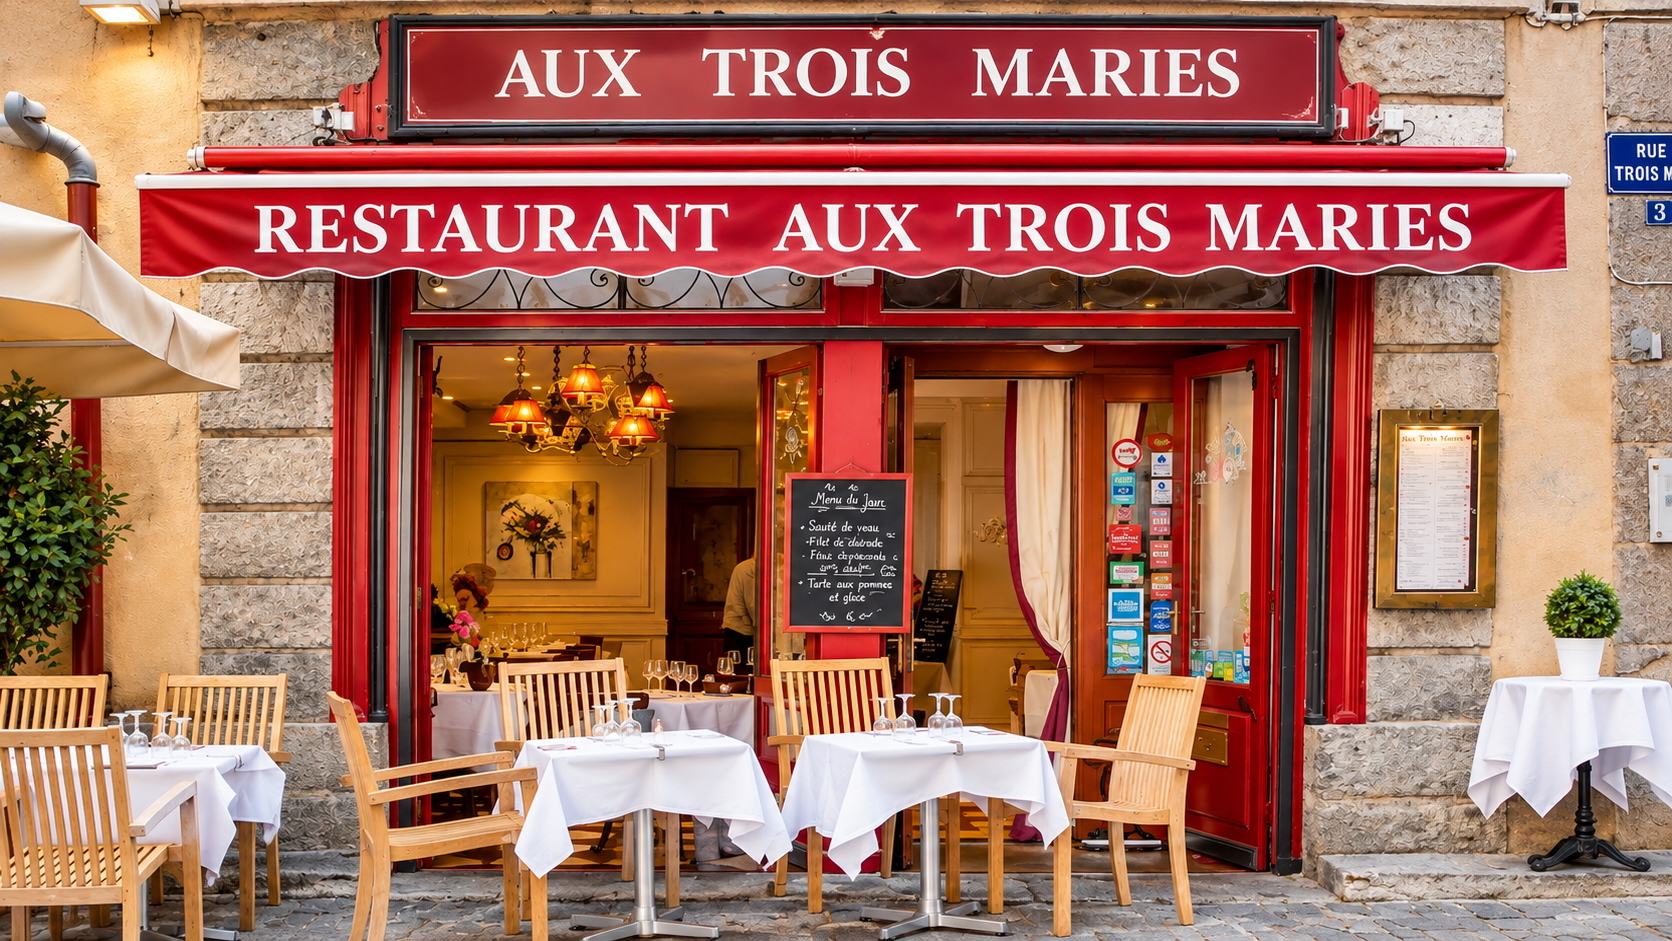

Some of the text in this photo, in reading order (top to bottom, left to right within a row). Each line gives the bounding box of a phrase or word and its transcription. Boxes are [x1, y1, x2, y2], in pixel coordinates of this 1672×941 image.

[495, 47, 1240, 98] AUX TROIS MARIES
[1636, 143, 1667, 158] RUE
[1614, 165, 1659, 181] TROIS
[1653, 203, 1666, 221] 3
[254, 202, 1472, 253] RESTAURANT AUX TROIS MARIES
[811, 492, 842, 505] Menu
[846, 493, 858, 504] du
[807, 578, 831, 589] Tarte
[836, 581, 854, 589] aux
[829, 592, 839, 602] et
